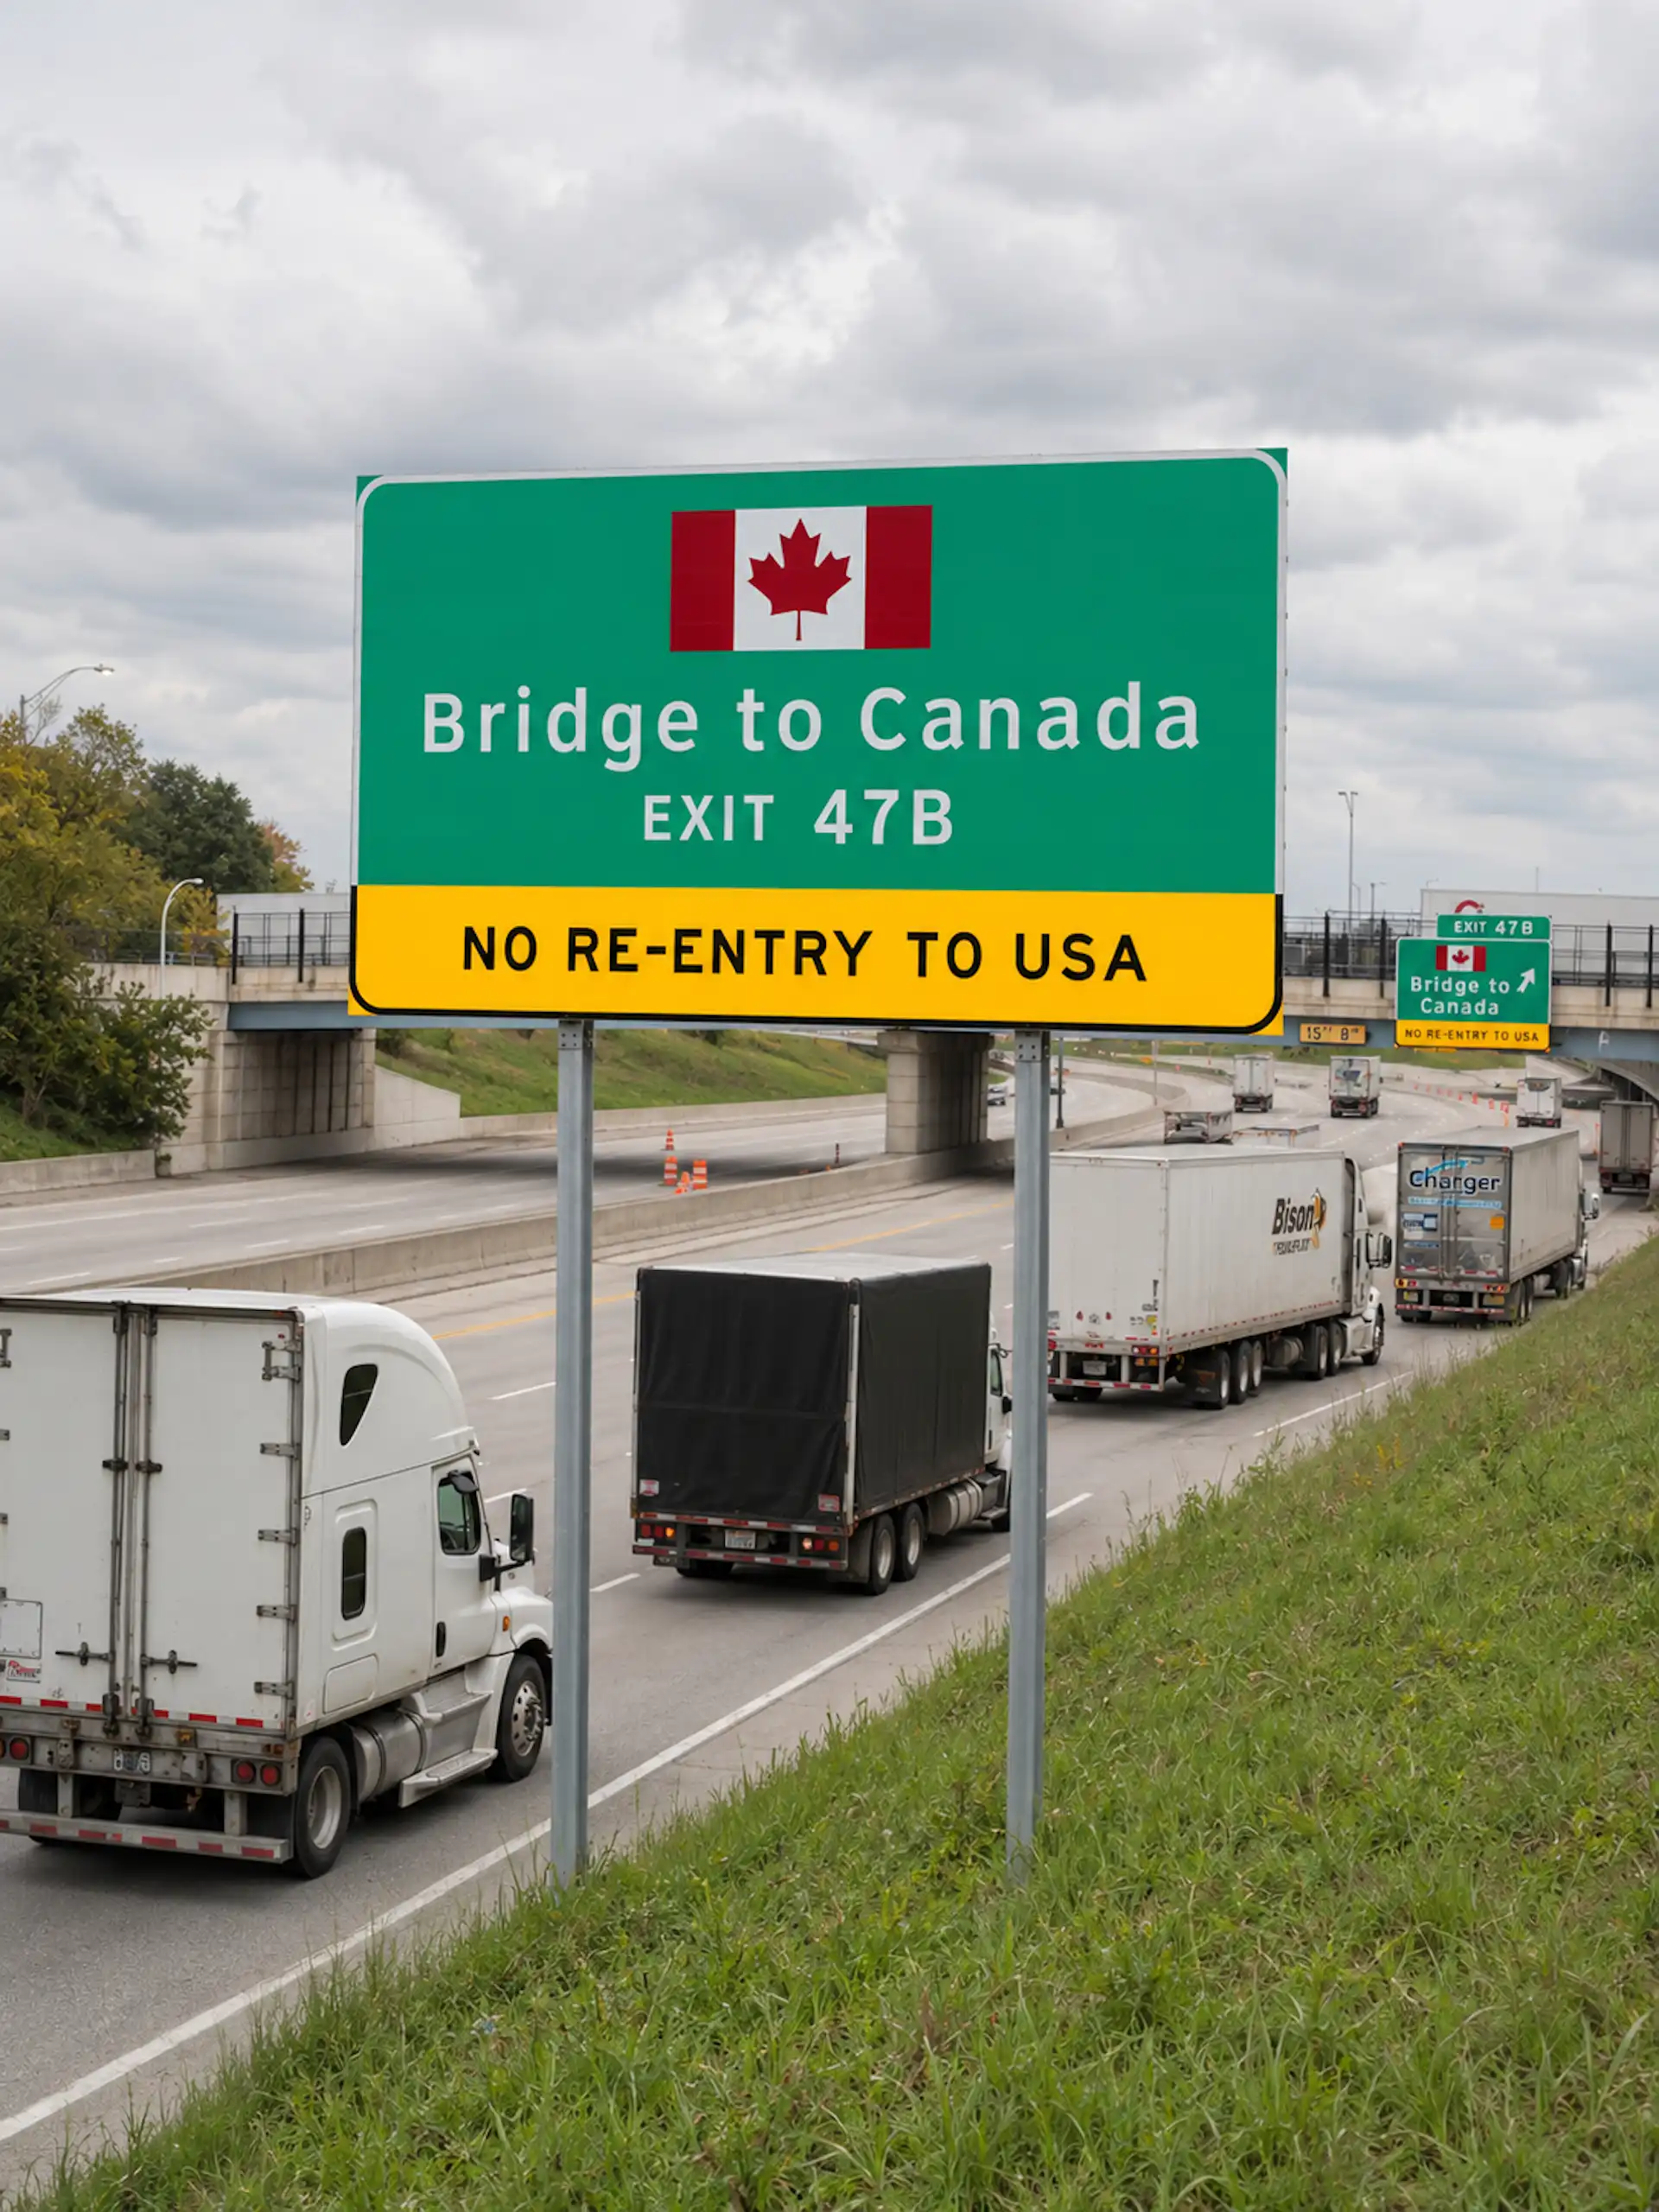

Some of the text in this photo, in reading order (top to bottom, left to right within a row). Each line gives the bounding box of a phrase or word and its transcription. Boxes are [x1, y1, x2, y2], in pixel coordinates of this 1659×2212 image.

[423, 681, 1199, 772] Bridge to Canada
[644, 789, 952, 845] EXIT 47B
[1454, 920, 1533, 935] EXIT 47B
[463, 925, 1147, 982] NO RE-ENTRY TO USA
[1411, 976, 1510, 998] Bridge to
[1421, 997, 1499, 1015] Canada
[1405, 1029, 1539, 1042] NO RE-ENTRY TO USA
[1409, 1167, 1500, 1194] Charger
[1271, 1198, 1314, 1235] Bison
